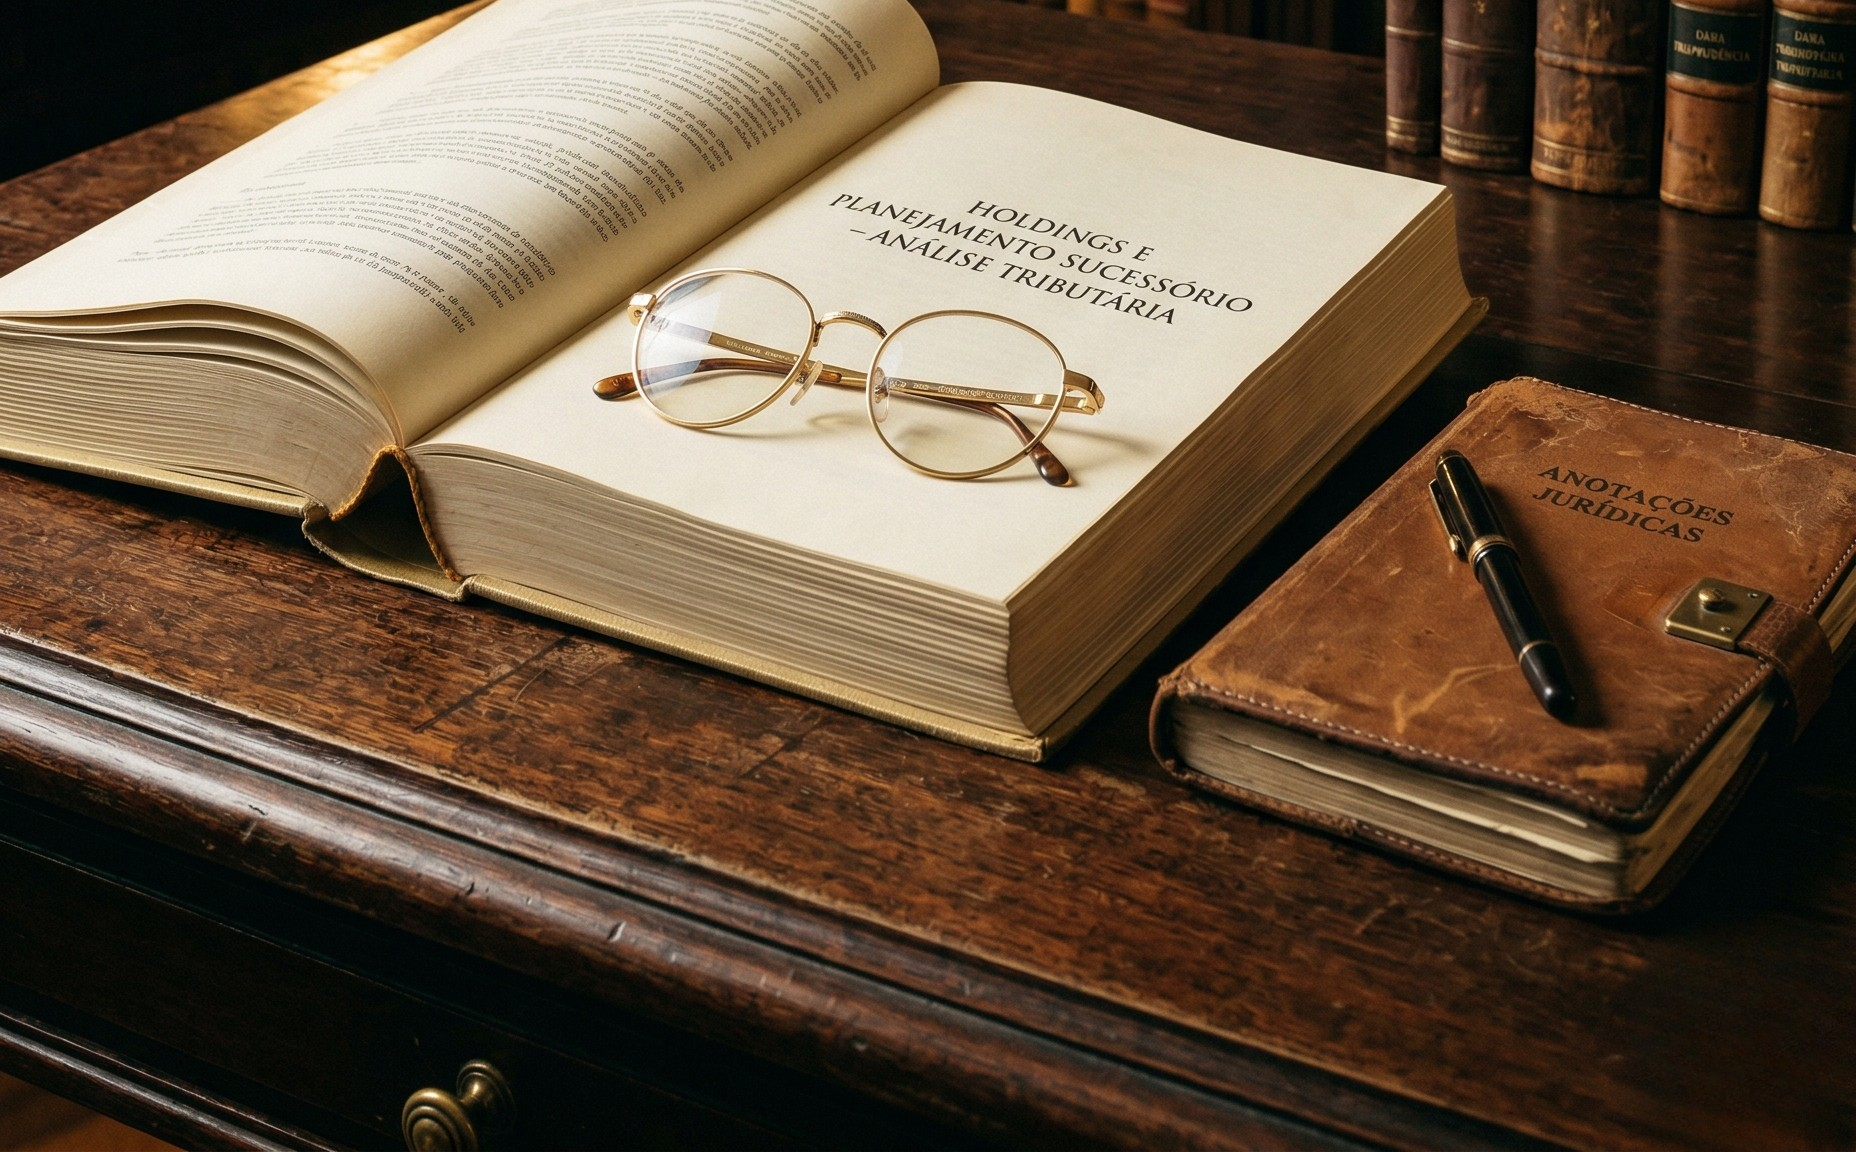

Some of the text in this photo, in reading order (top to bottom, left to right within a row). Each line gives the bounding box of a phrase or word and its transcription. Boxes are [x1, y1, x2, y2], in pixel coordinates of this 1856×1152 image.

[829, 193, 1253, 313] PLANEJAMENTO SUCESSÓRIO
[967, 200, 1155, 262] HOLDINGS E
[865, 229, 994, 273] ANÁLISE
[998, 262, 1176, 325] TRIBUTÁRIA
[1533, 487, 1705, 543] JURÍDICAS
[1538, 466, 1734, 526] ANOTAÇÕES
